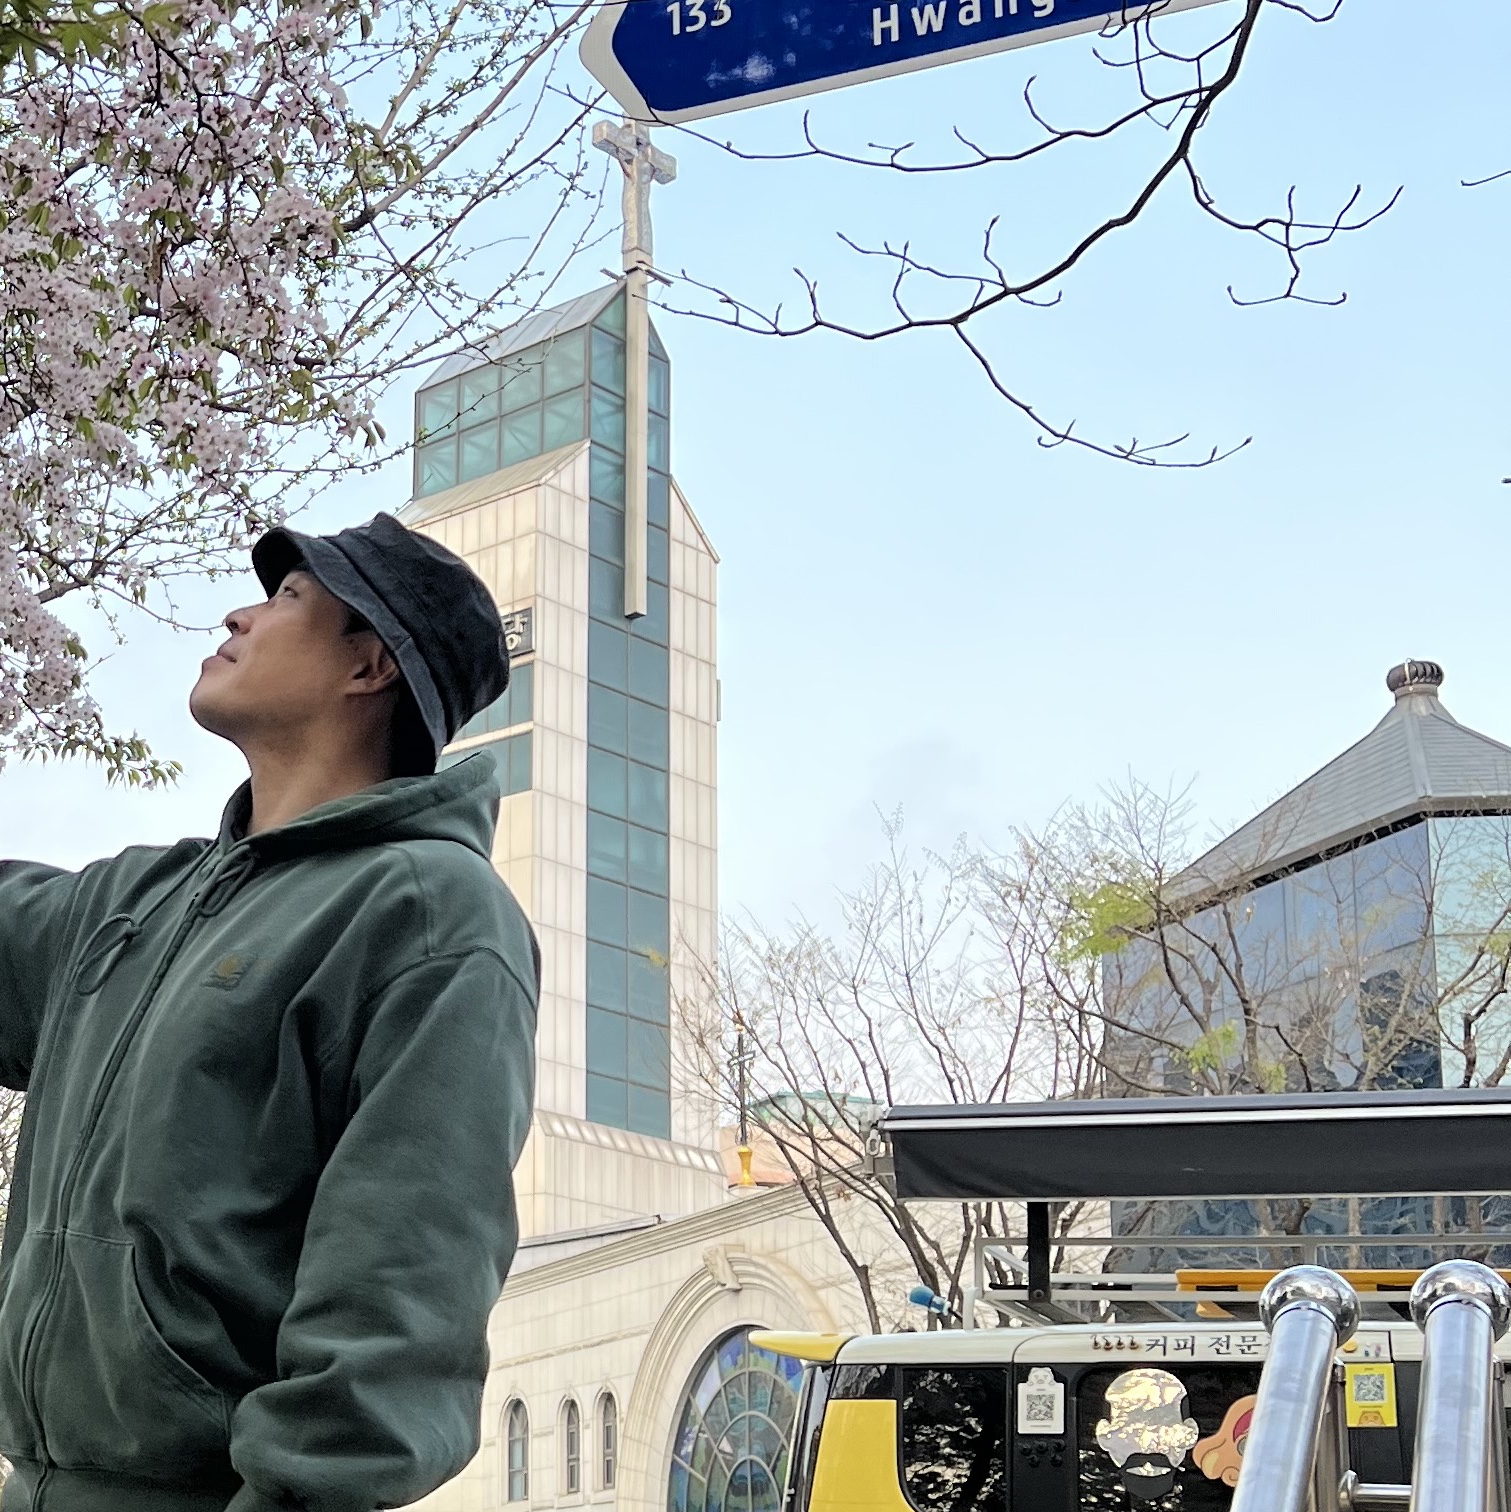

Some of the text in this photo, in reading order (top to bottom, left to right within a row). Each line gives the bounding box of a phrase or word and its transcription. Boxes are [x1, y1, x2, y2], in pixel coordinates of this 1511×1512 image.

[666, 0, 732, 36] 133
[1145, 1334, 1271, 1357] 커피 전문
